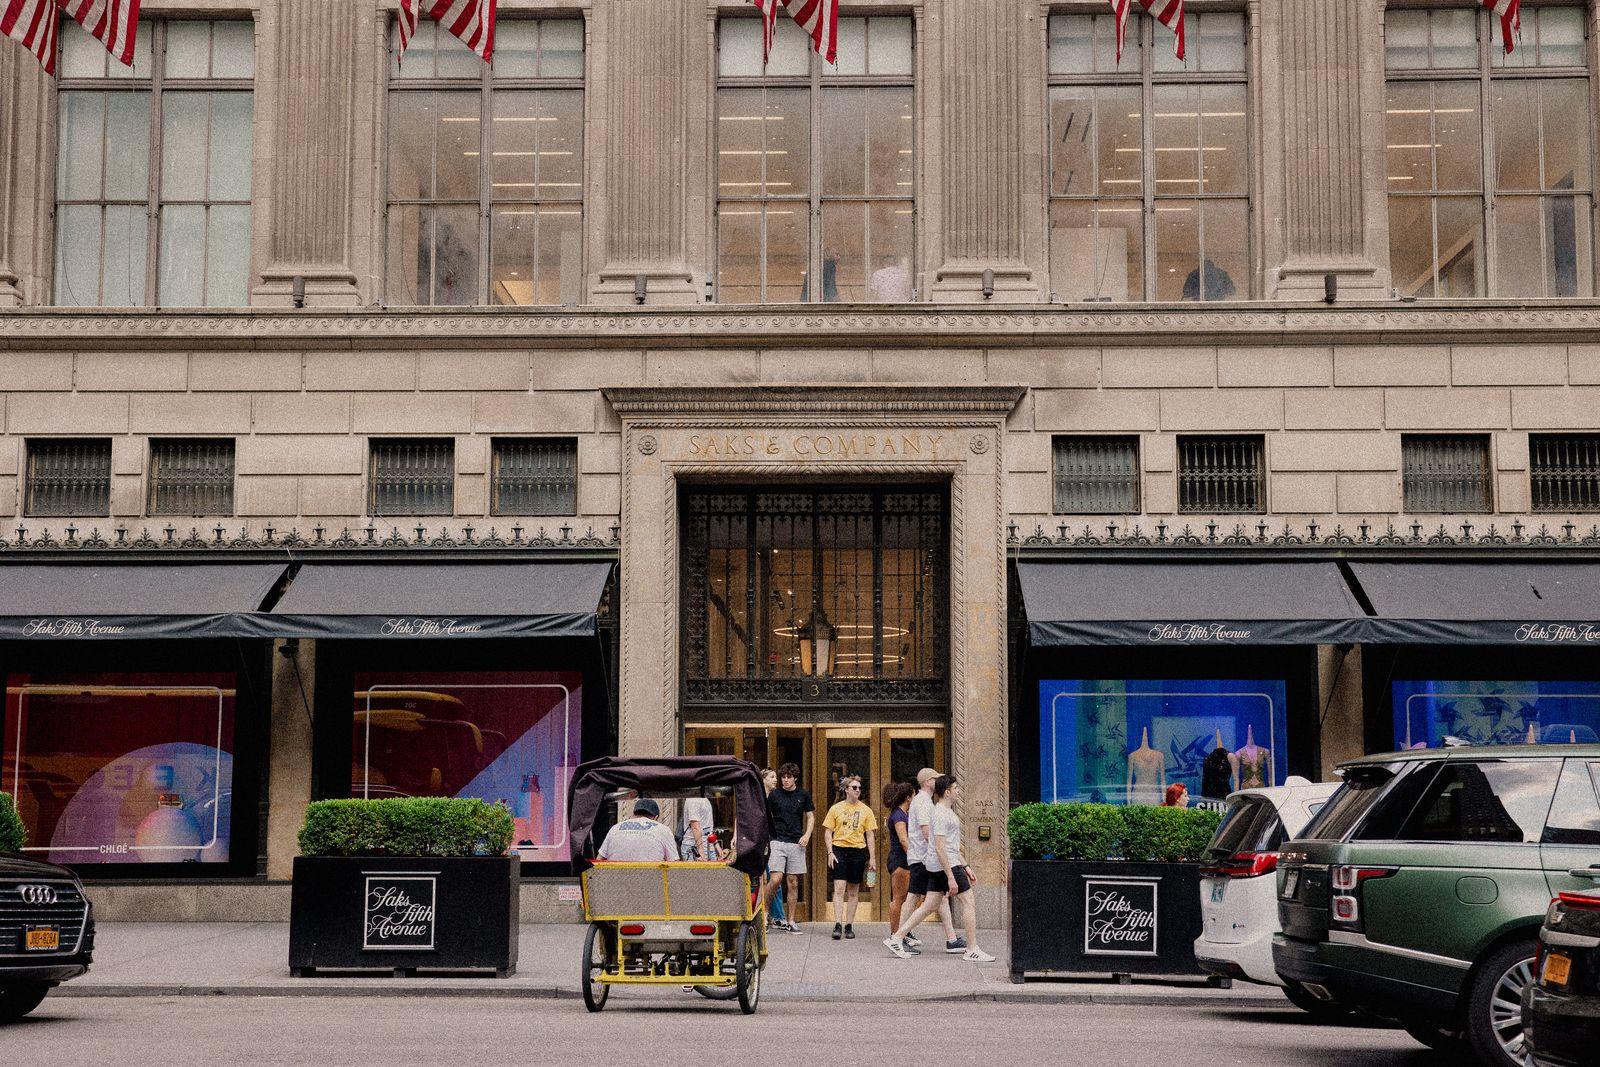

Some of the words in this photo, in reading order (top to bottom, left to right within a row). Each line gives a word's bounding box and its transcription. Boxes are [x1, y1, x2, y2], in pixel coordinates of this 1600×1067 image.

[689, 435, 754, 455] SAKS
[766, 435, 780, 455] &
[793, 434, 943, 455] COMPANY
[22, 619, 56, 636] Saks
[51, 619, 83, 636] Fifth
[77, 618, 125, 636] Avenue
[380, 618, 414, 635] Saks
[409, 618, 440, 635] Fifth
[433, 618, 481, 635] Avenue
[1148, 623, 1182, 641] Saks
[1177, 623, 1209, 641] Fifth
[1201, 623, 1251, 641] Avenue
[1514, 623, 1549, 641] Saks
[1545, 623, 1578, 641] Fifth
[810, 684, 820, 697] 3
[99, 842, 128, 854] CHLOÉ
[367, 886, 411, 914] Saks
[1088, 891, 1132, 919] Saks
[389, 903, 433, 925] Fifth
[1110, 909, 1155, 930] Fifth
[367, 915, 427, 939] Avenue
[1088, 919, 1149, 944] Avenue
